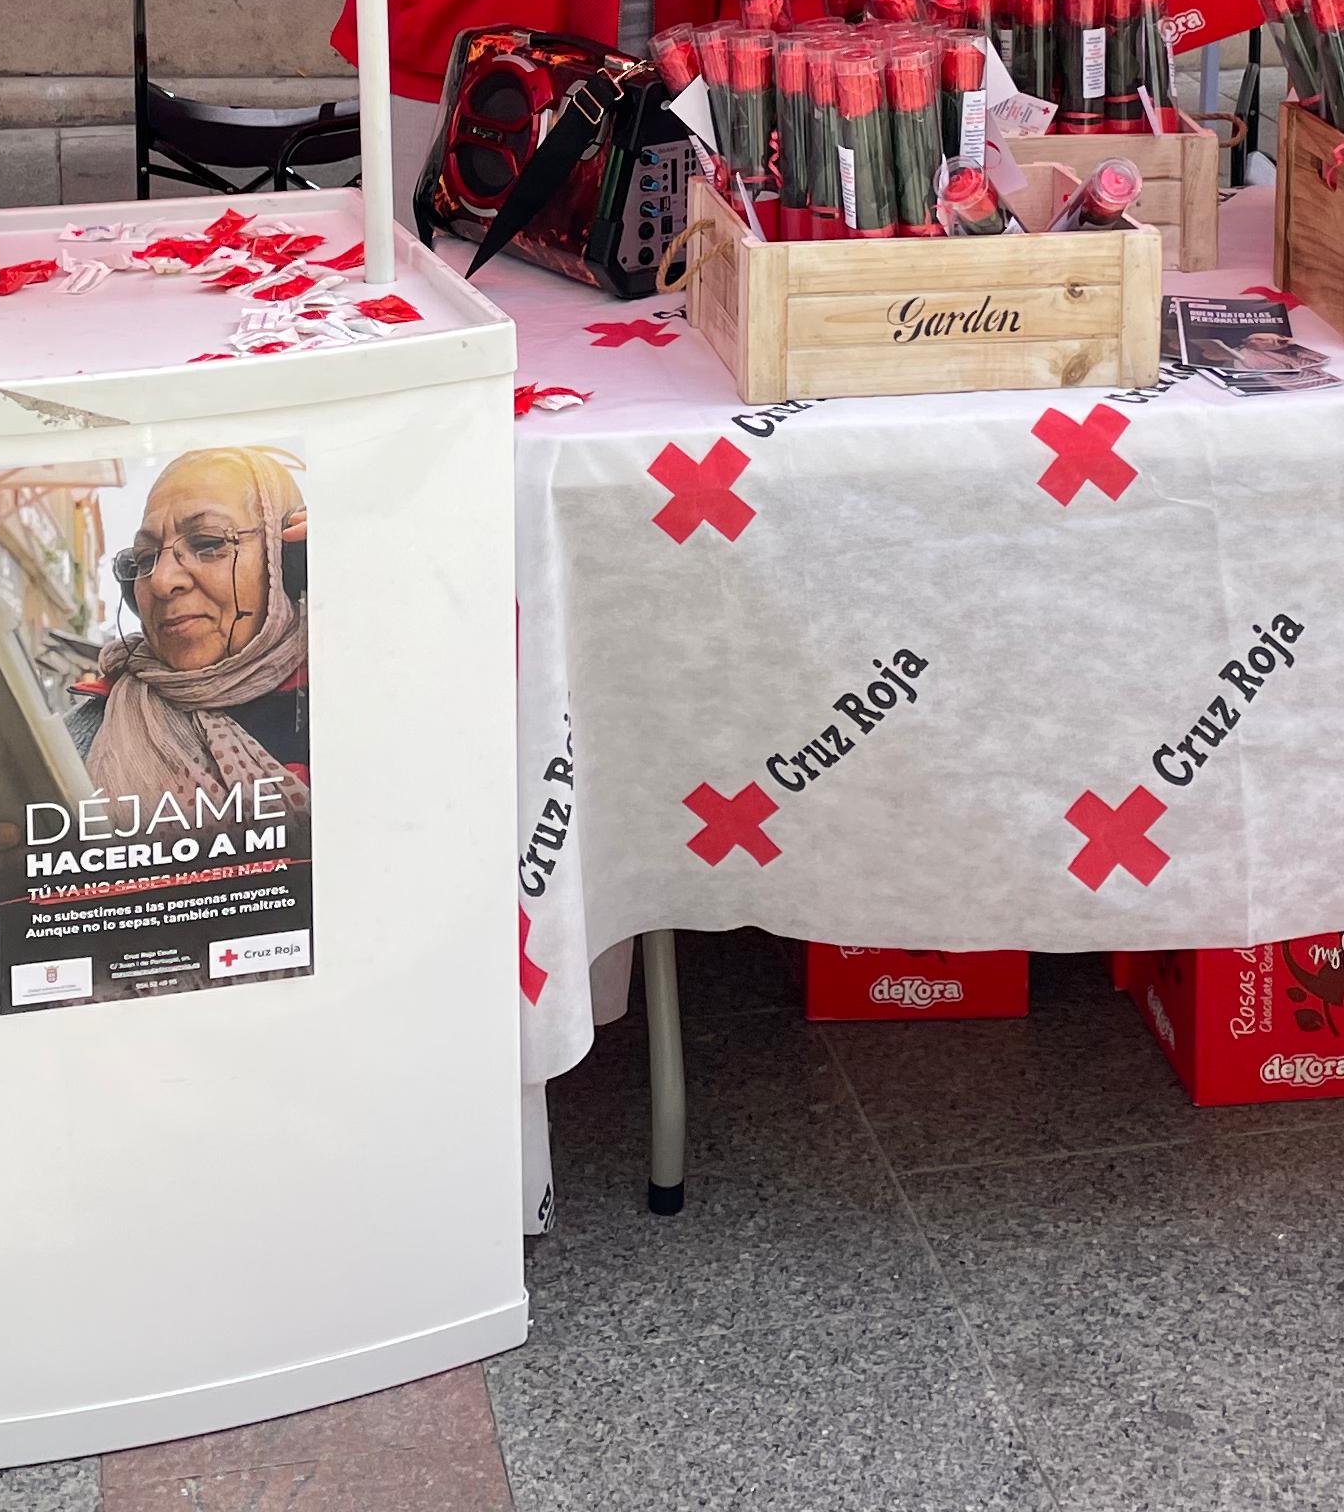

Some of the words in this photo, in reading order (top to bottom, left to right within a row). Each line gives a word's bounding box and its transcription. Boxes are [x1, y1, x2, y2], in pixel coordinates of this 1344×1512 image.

[1160, 10, 1204, 43] ora
[887, 295, 1022, 343] Garden
[1152, 695, 1242, 786] Cruz
[1218, 613, 1305, 703] Roja
[766, 724, 856, 792] Cruz
[833, 648, 929, 735] Roja
[26, 776, 286, 846] DÉJAME
[26, 838, 199, 877] HACERLO
[208, 833, 236, 858] A
[245, 825, 286, 852] MI
[519, 798, 572, 897] Cruz
[32, 913, 51, 924] No
[54, 906, 132, 921] subestimes
[135, 905, 143, 914] a
[146, 902, 165, 912] las
[168, 894, 227, 911] personas
[230, 886, 289, 901] mayores.
[56, 884, 80, 898] YA
[26, 925, 79, 938] Aunque
[83, 922, 100, 932] no
[103, 920, 116, 930] lo
[119, 916, 161, 929] sepas,
[164, 908, 218, 924] también
[221, 906, 236, 916] es
[240, 898, 295, 913] maltrato
[244, 948, 272, 960] Cruz
[274, 944, 301, 957] Roja
[1234, 948, 1256, 963] d
[1259, 944, 1273, 973] Rose
[1309, 944, 1341, 969] My
[871, 976, 962, 1008] deKora
[1230, 971, 1256, 1039] Rosas
